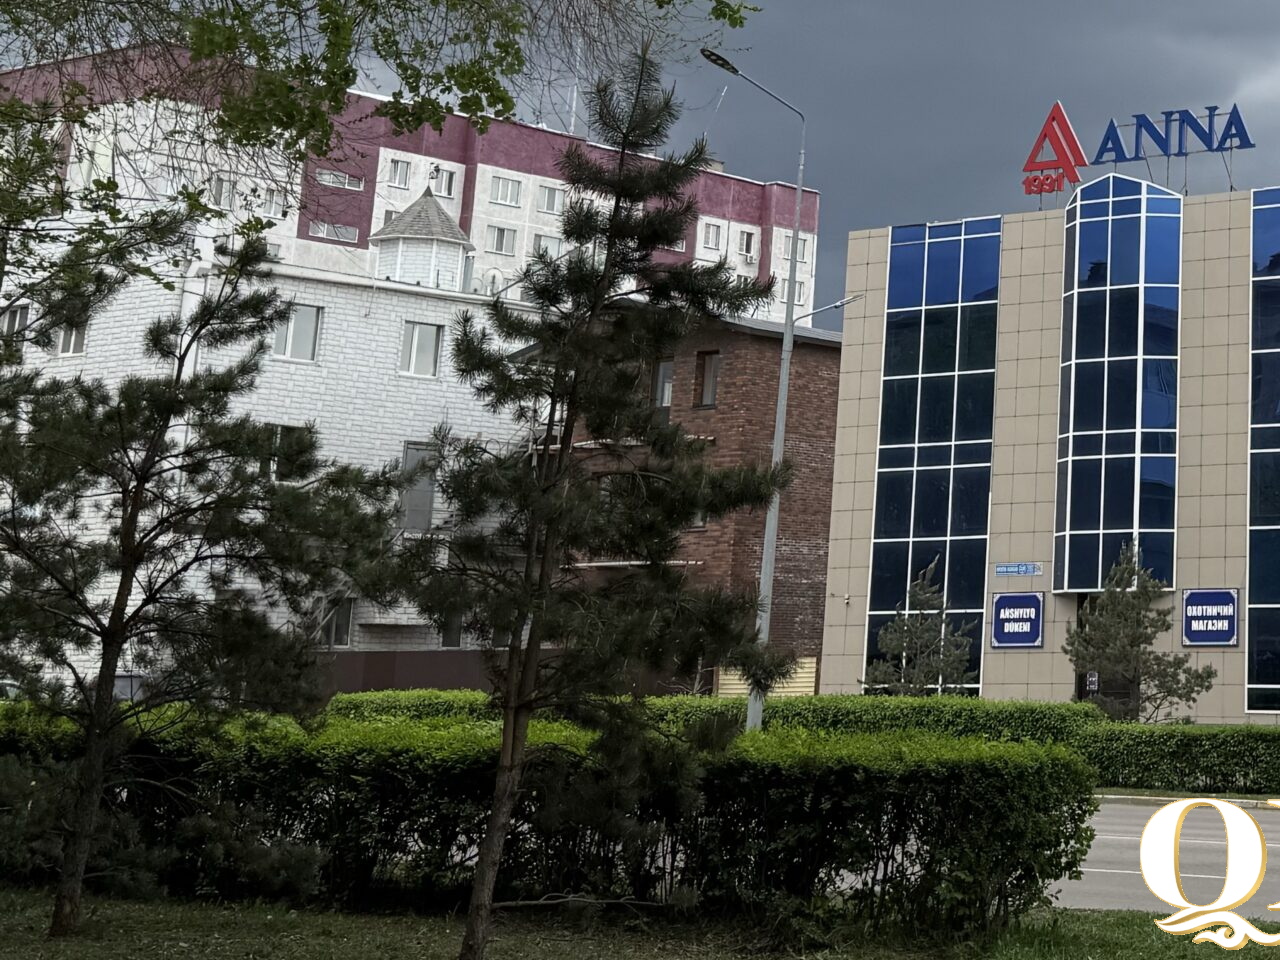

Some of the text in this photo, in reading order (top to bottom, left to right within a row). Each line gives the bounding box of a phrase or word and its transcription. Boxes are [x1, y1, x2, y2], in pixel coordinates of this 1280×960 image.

[1090, 103, 1256, 165] ANNA
[1022, 173, 1064, 195] 1991
[1186, 603, 1233, 617] ОХОТНИЧИЙ
[1191, 619, 1229, 631] МАГАЗИН
